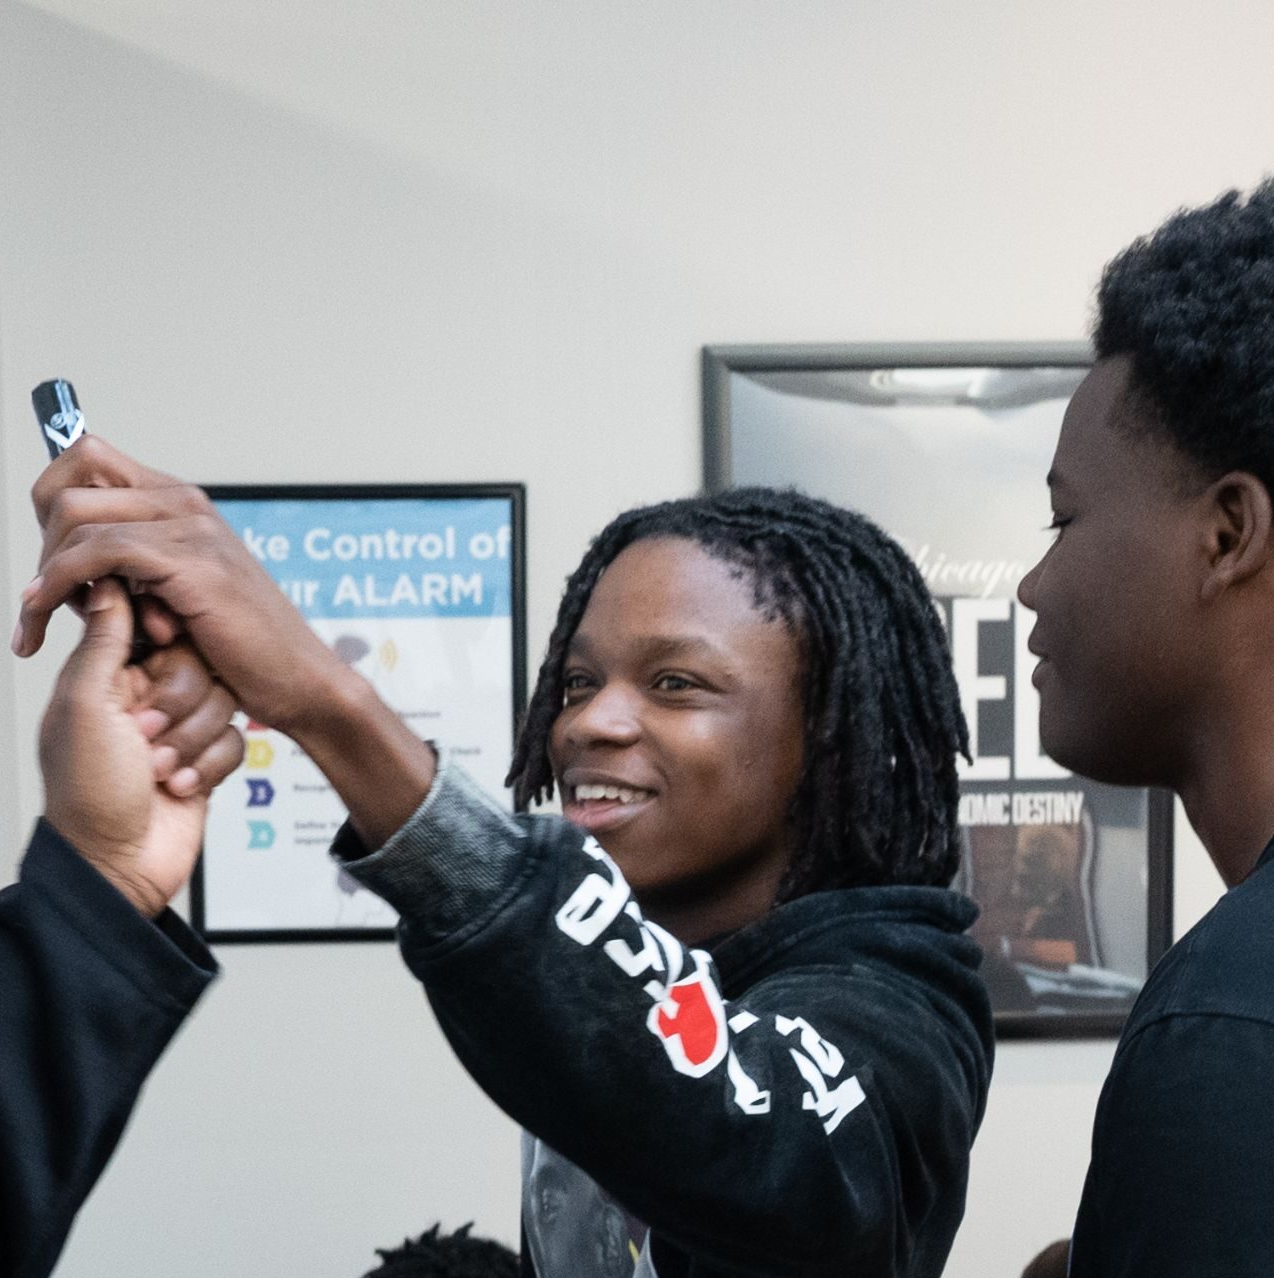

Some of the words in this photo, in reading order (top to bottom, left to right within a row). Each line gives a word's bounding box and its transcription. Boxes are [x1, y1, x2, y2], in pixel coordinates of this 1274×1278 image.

[243, 526, 290, 561] ke
[303, 526, 456, 561] Control
[469, 525, 512, 560] of
[284, 578, 320, 606] ur
[333, 573, 485, 607] ALARM
[913, 546, 1025, 600] hicago
[1013, 791, 1084, 825] DESTINY
